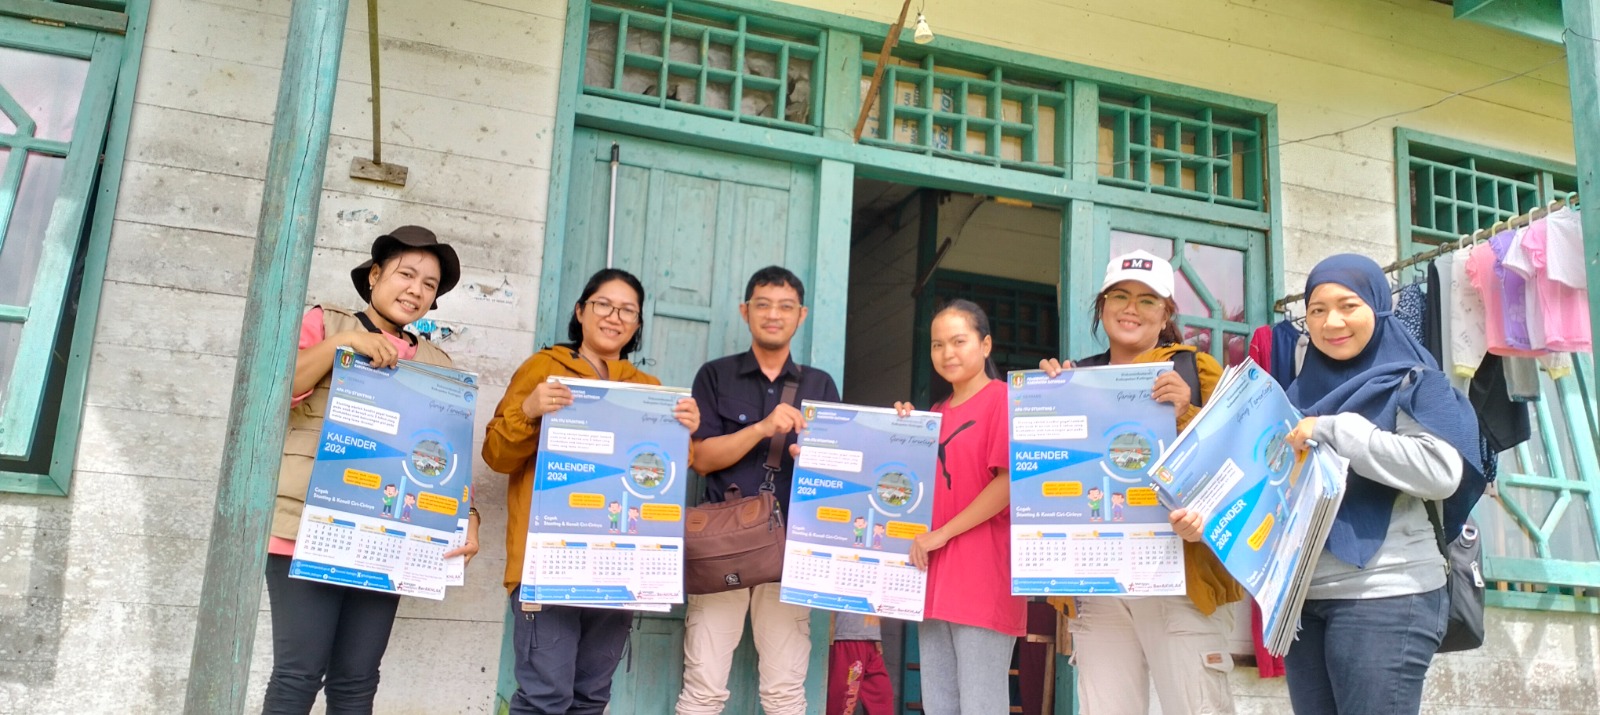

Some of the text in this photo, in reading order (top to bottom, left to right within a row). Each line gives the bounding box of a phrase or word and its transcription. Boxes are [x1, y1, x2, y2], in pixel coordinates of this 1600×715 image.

[1131, 259, 1143, 268] M
[327, 432, 377, 451] KALENDER
[324, 443, 346, 455] 2024
[1016, 451, 1068, 460] KALENDER
[548, 462, 595, 472] KALENDER
[1016, 462, 1038, 470] 2024
[547, 472, 567, 481] 2024
[798, 477, 843, 488] KALENDER
[314, 487, 328, 495] Cegah
[797, 486, 816, 495] 2024
[314, 493, 332, 502] Stunting
[1210, 499, 1247, 541] KALENDER
[1216, 530, 1232, 550] 2024
